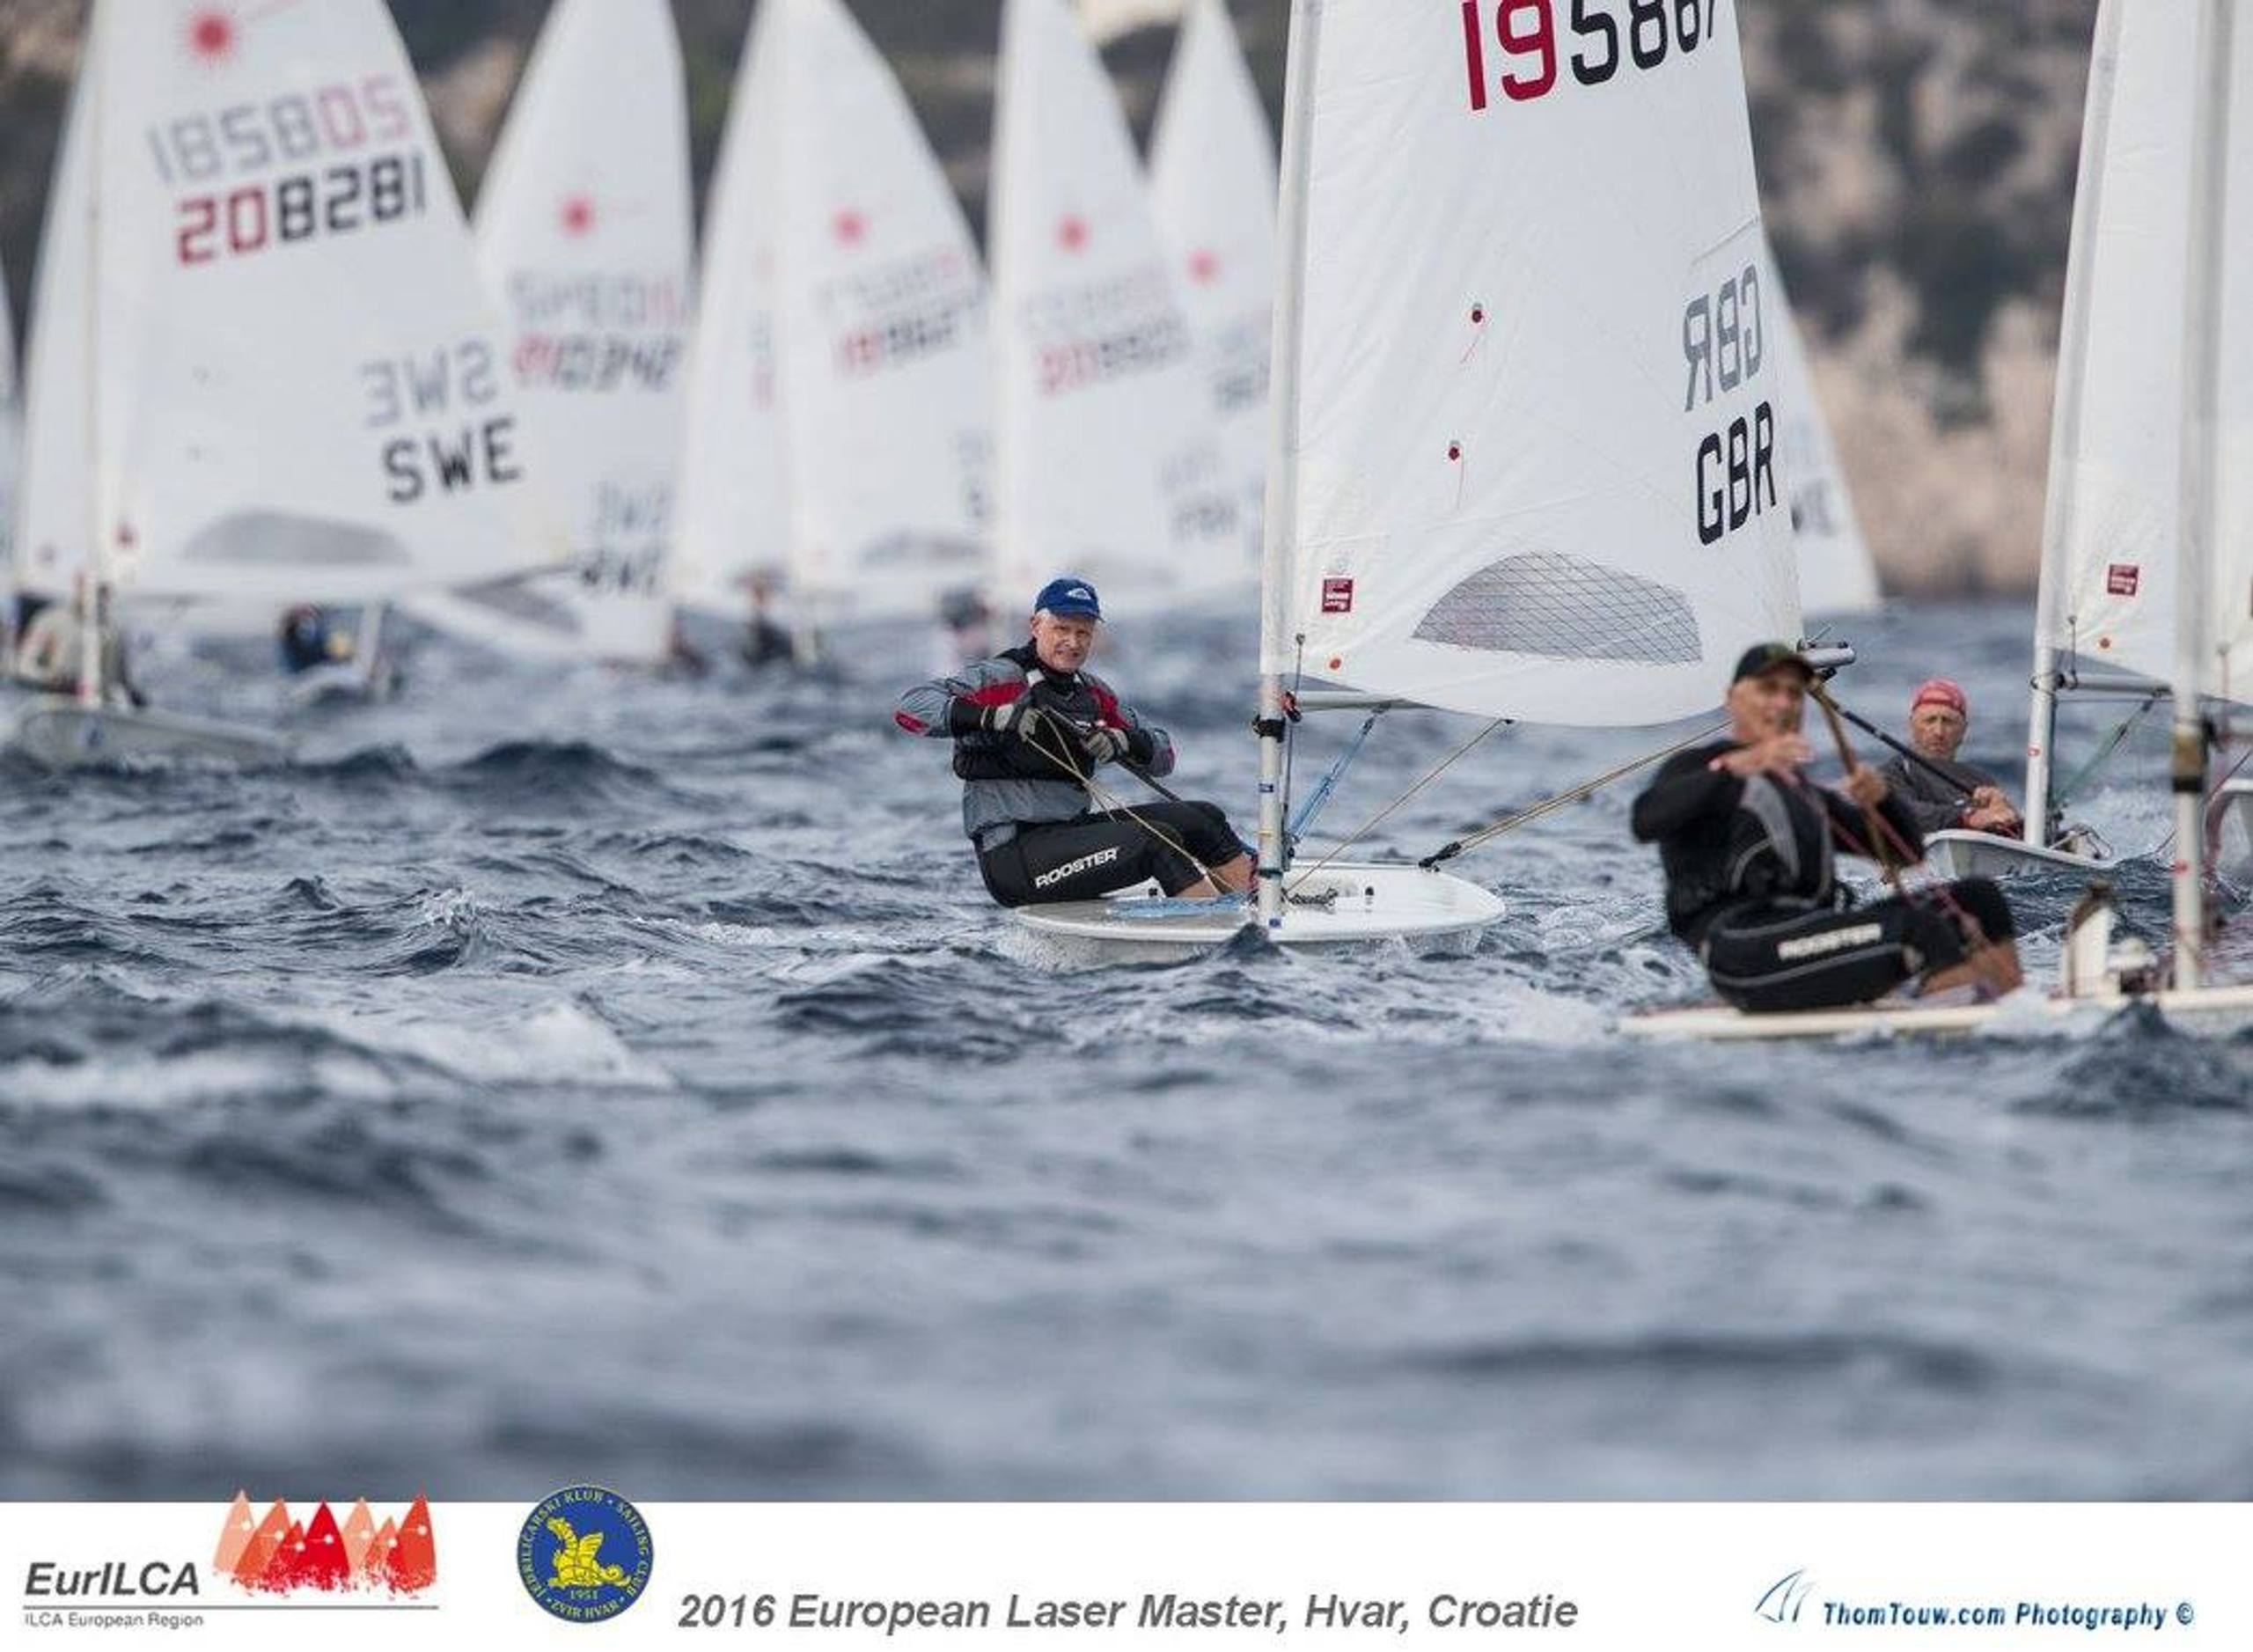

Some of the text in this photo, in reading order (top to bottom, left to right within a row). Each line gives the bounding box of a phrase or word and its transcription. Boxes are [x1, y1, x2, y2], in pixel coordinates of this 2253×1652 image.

[176, 148, 427, 266] 208281
[382, 415, 525, 504] SWE
[1697, 401, 1776, 546] GBR
[1035, 847, 1119, 888] ROOSTER
